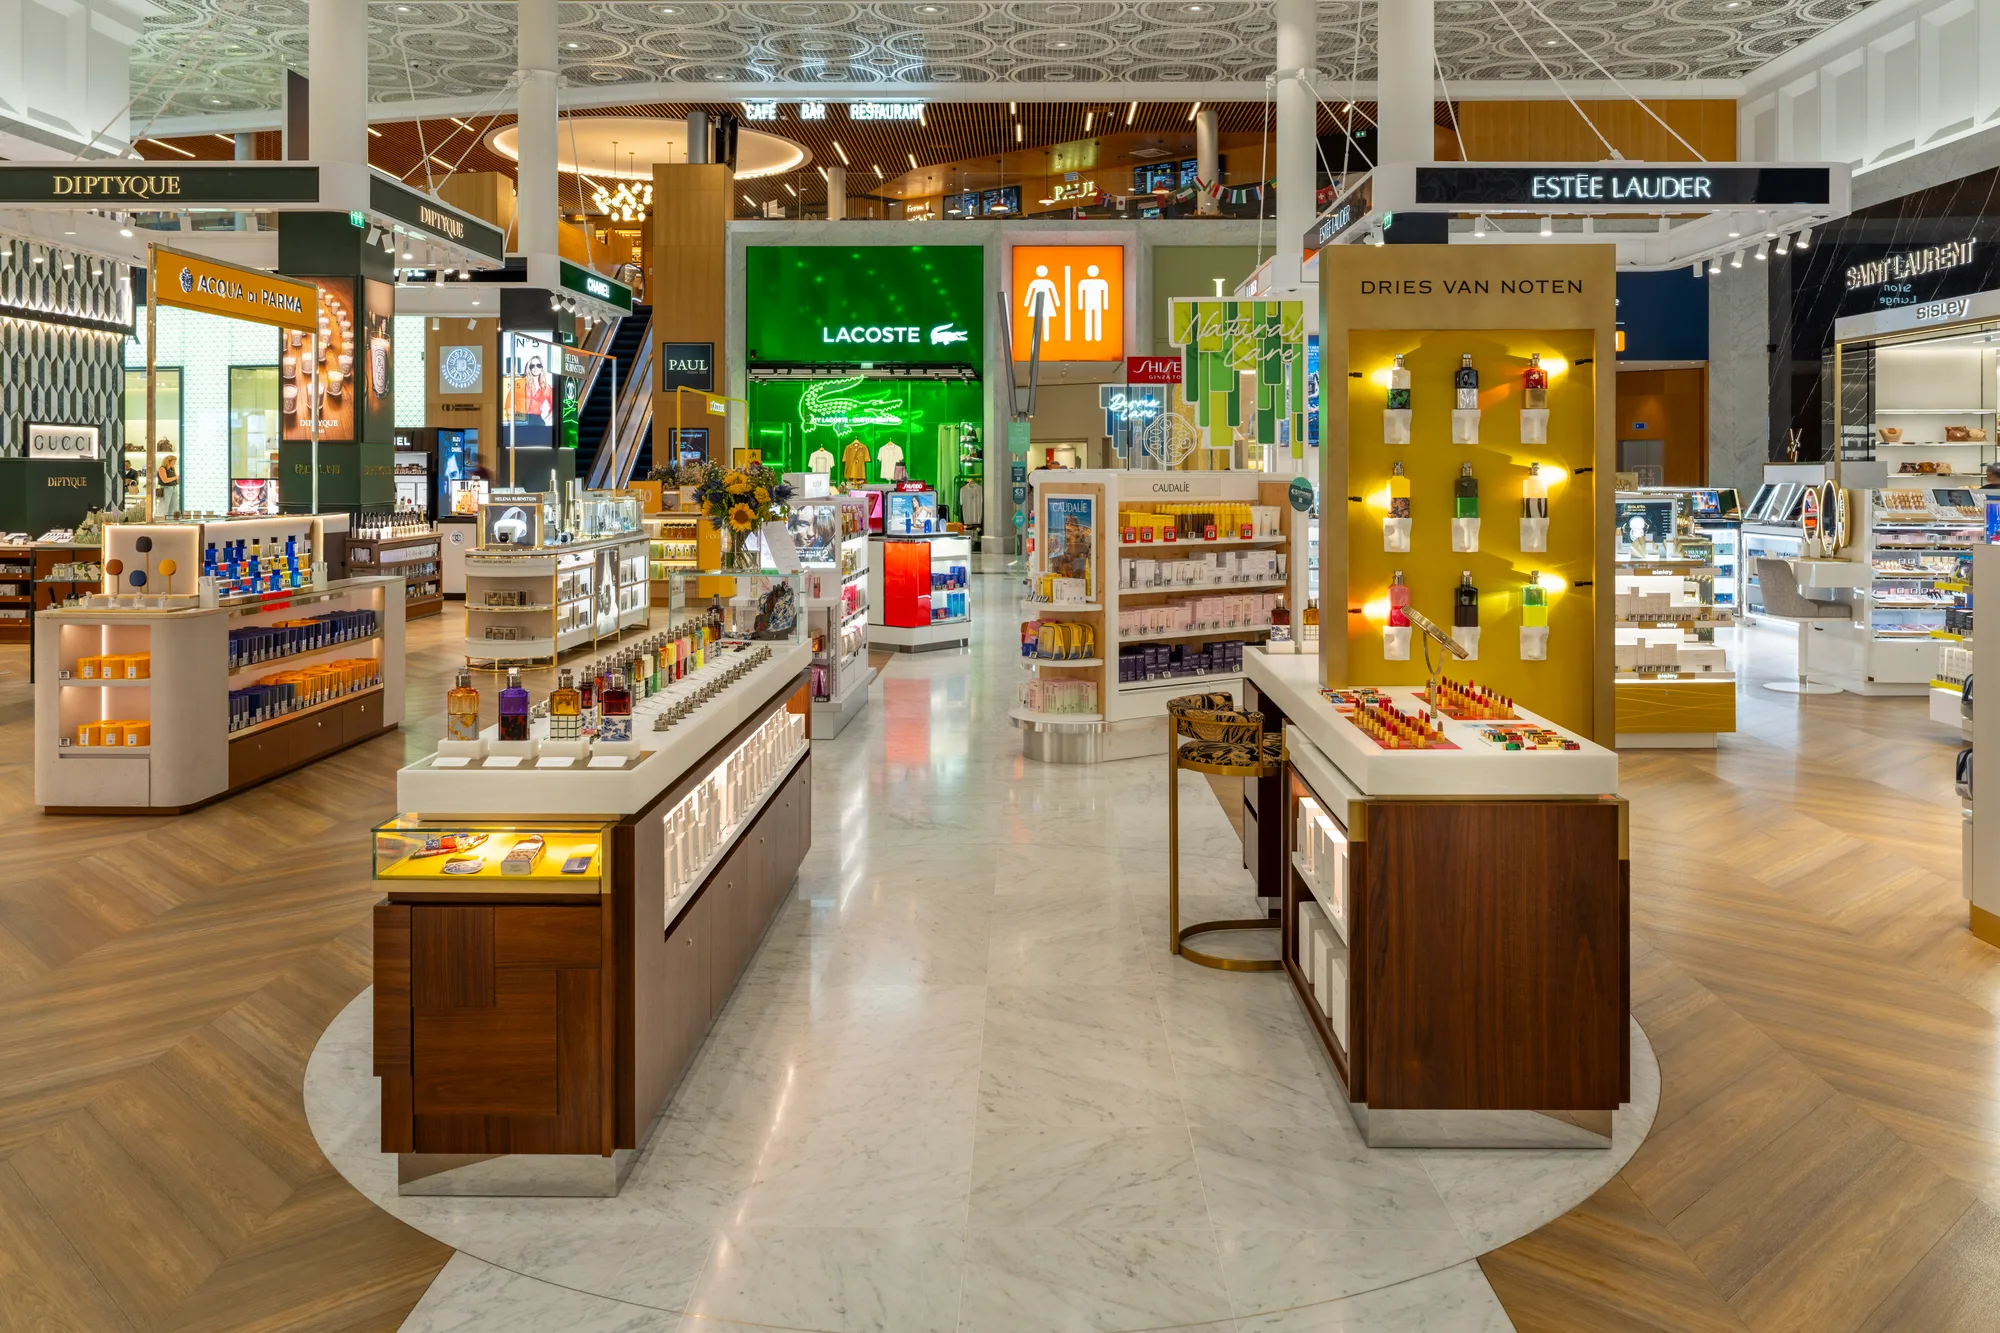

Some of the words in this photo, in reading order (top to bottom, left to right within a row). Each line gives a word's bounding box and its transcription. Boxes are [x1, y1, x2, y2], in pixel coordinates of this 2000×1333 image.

[746, 102, 776, 119] CAFÉ
[802, 103, 825, 119] BAR
[851, 103, 925, 119] RESTAURANT
[53, 175, 181, 199] DIPTYQUE
[1612, 176, 1711, 199] LAUDER
[420, 205, 464, 239] DIPTYQUE
[1331, 204, 1350, 235] LAUDER
[1846, 256, 1891, 290] SAINT
[1893, 236, 1977, 280] LAURENT
[197, 274, 245, 302] ACQUA
[261, 289, 303, 313] PARMA
[587, 277, 610, 298] CHANEL
[1361, 280, 1432, 294] DRIES
[1443, 280, 1489, 294] VAN
[1501, 279, 1583, 294] NOTEN
[823, 326, 920, 343] LACOSTE
[1178, 310, 1305, 345] Natural
[565, 353, 580, 365] HELENA
[1223, 337, 1301, 368] Care
[565, 362, 586, 375] RUBINSTEIN
[669, 360, 709, 371] PAUL
[1109, 393, 1160, 410] Derma
[1120, 406, 1157, 421] Care
[299, 419, 339, 428] DIPYQUE
[34, 434, 92, 451] GUCCI
[47, 476, 88, 488] DIPTYQUE
[1152, 481, 1190, 493] CAUDALÍE
[1053, 500, 1088, 512] CAUDALÍE
